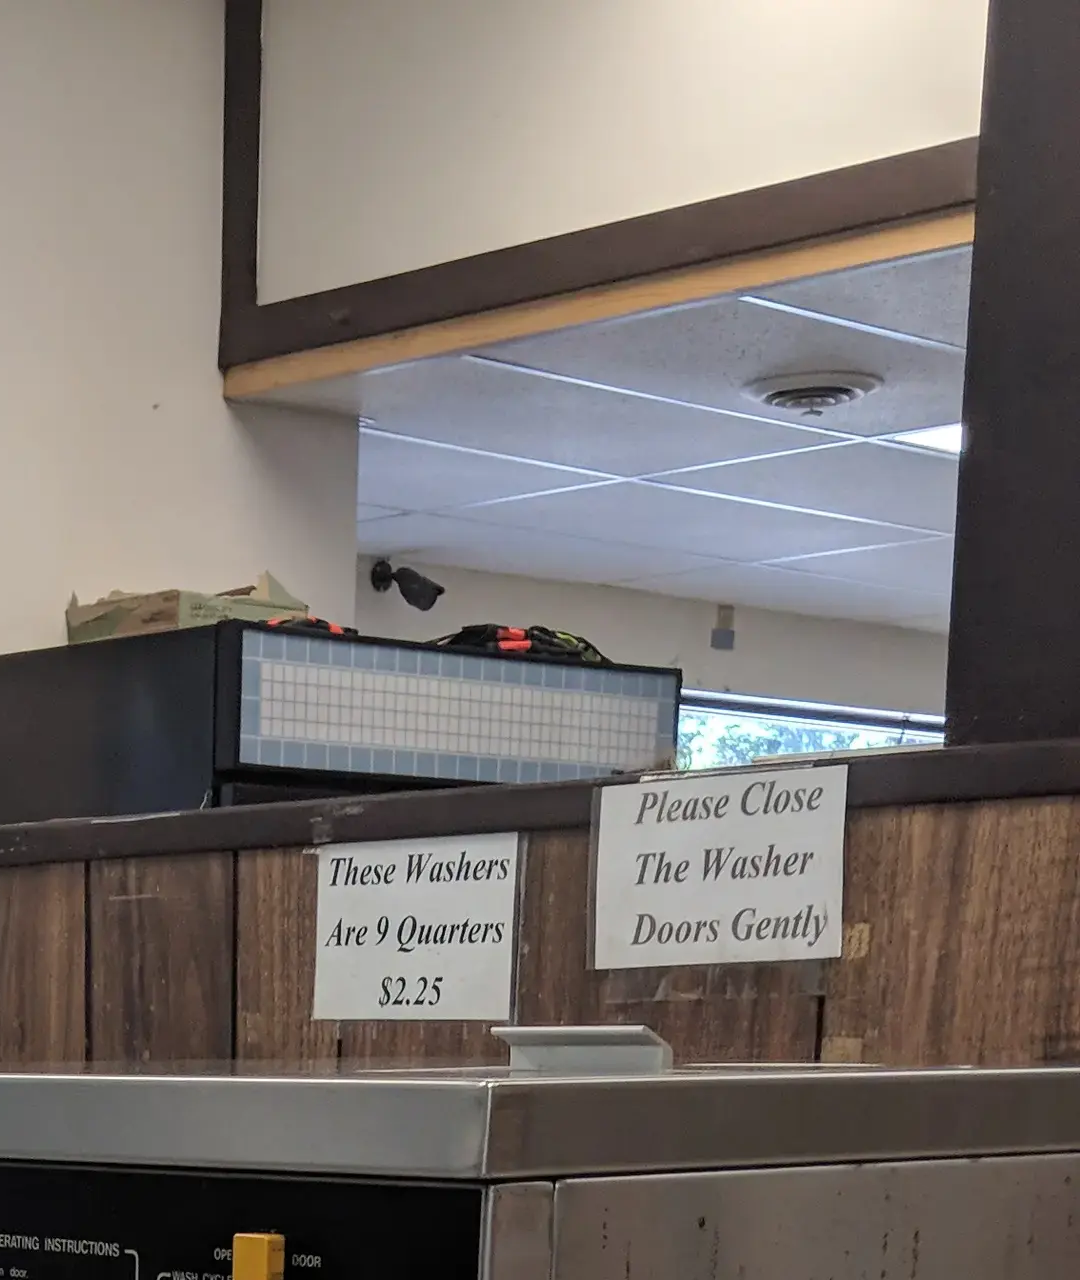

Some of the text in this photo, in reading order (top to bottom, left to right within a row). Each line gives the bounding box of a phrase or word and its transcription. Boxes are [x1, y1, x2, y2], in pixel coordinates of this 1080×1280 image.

[634, 780, 824, 826] Please Close
[329, 850, 511, 887] These Washers
[634, 844, 815, 886] The Washer
[324, 916, 505, 953] Are 9 Quarters
[630, 904, 829, 948] Doors Gently
[378, 976, 444, 1009] $2.25
[44, 1238, 120, 1257] INSTRUCTIONS
[214, 1248, 322, 1268] OPE DOOR
